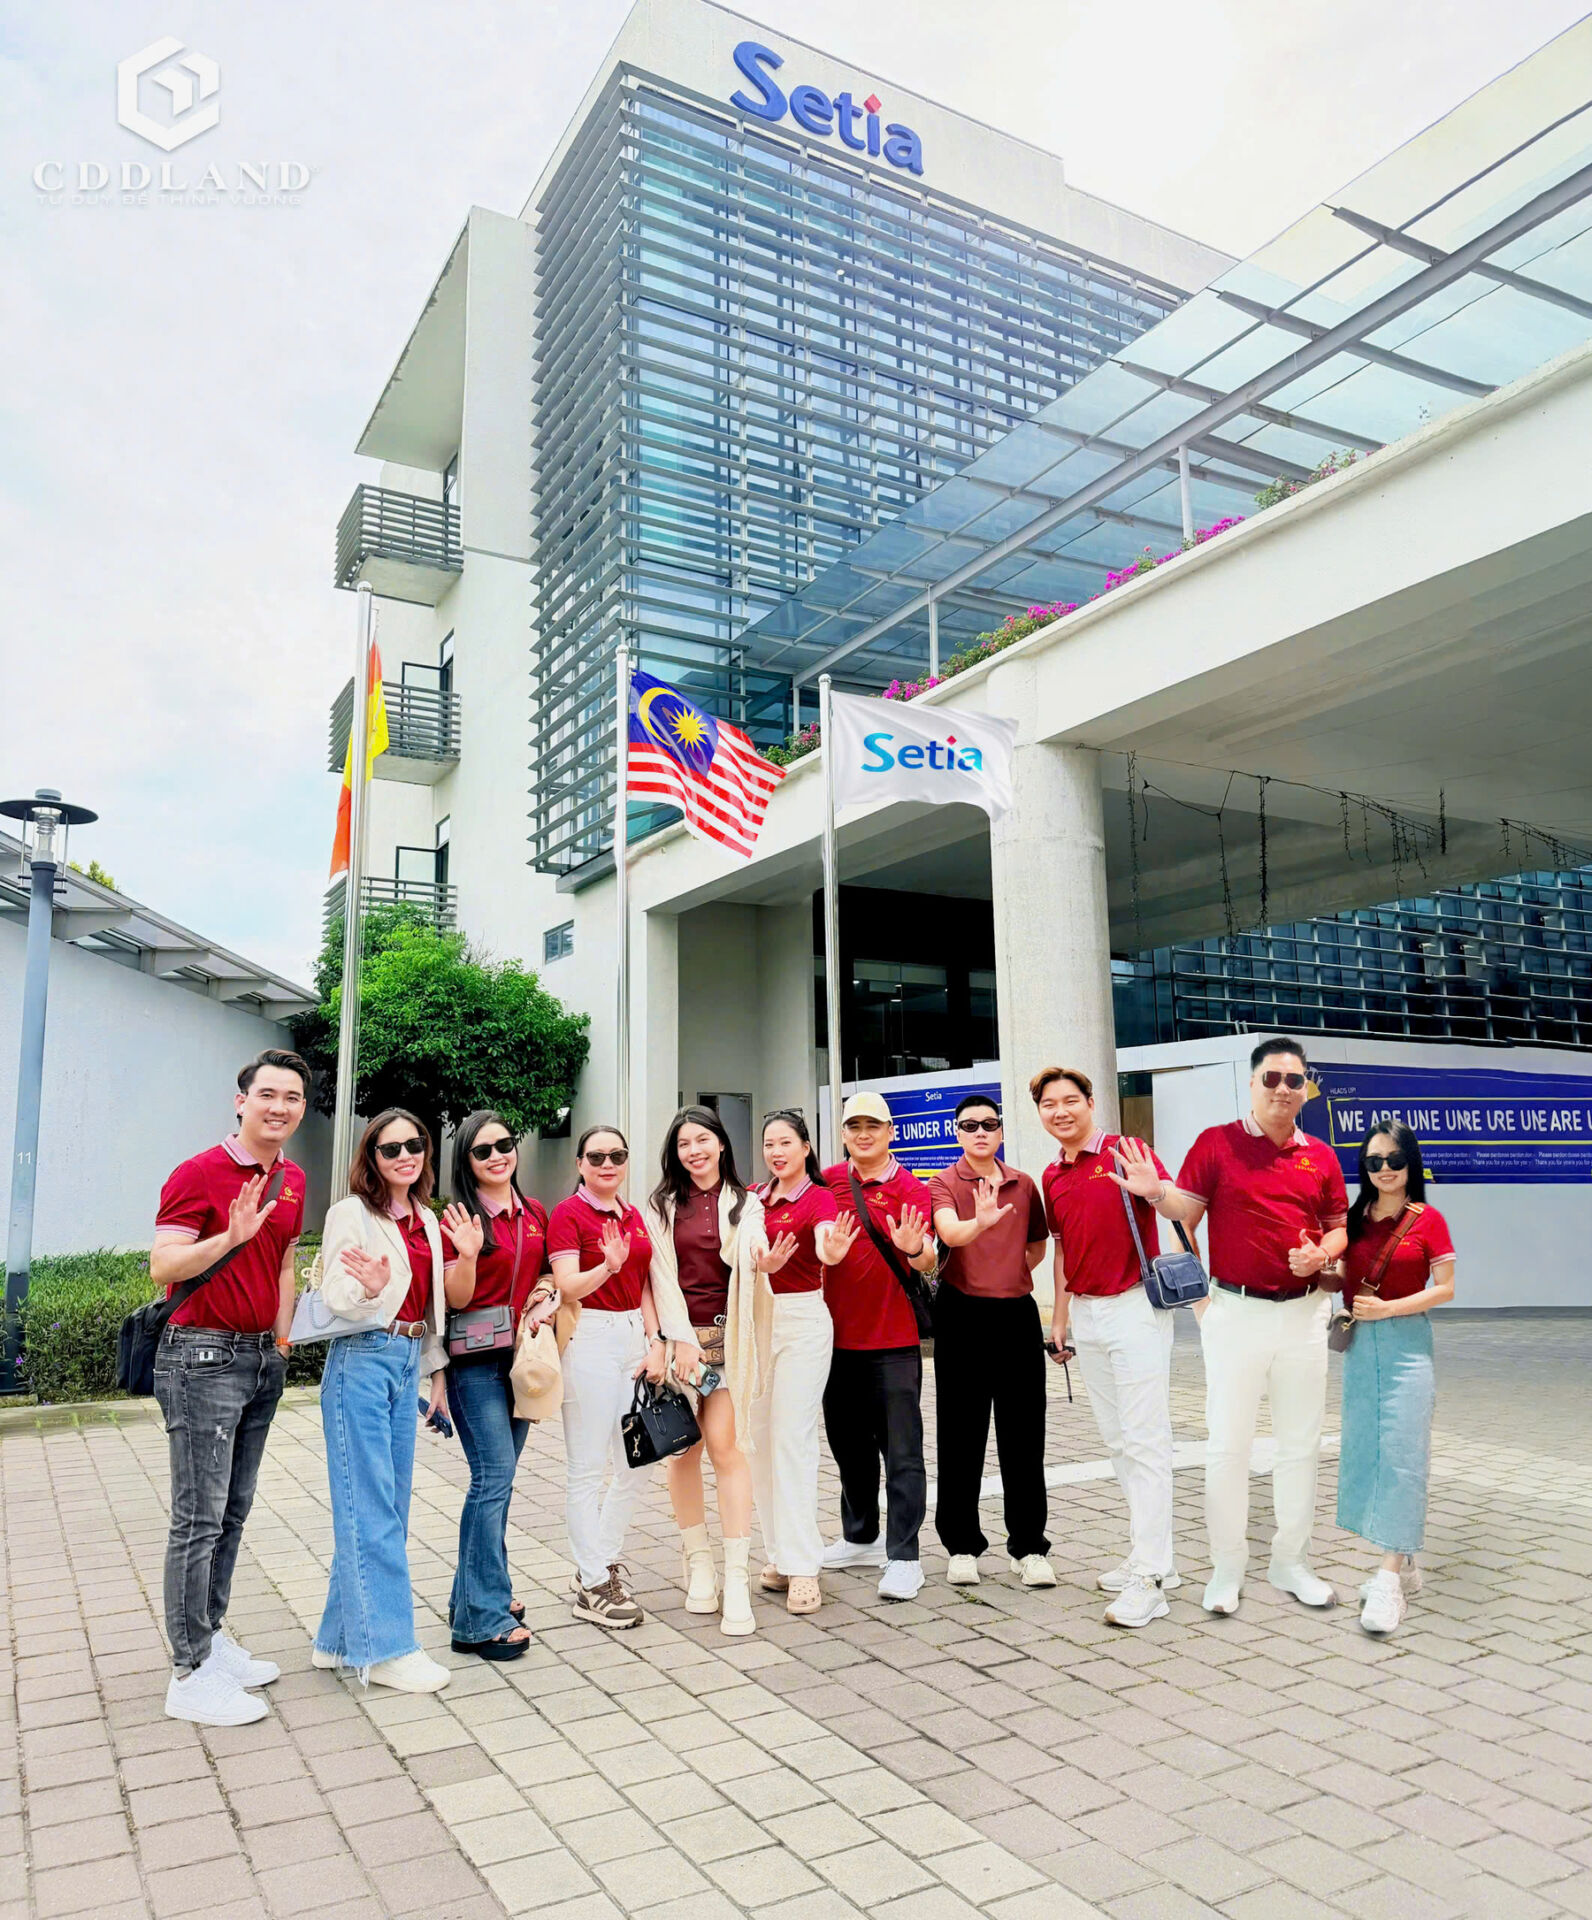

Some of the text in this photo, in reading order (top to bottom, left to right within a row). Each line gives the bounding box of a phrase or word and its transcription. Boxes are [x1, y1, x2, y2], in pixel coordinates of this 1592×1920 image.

[730, 41, 924, 176] Setia
[861, 732, 983, 773] Setia
[925, 1091, 942, 1102] Setia
[902, 1120, 941, 1140] UNDER
[1337, 1110, 1365, 1132] WE
[1407, 1109, 1440, 1131] UNE
[1550, 1109, 1583, 1131] ARE
[16, 1151, 31, 1165] 11
